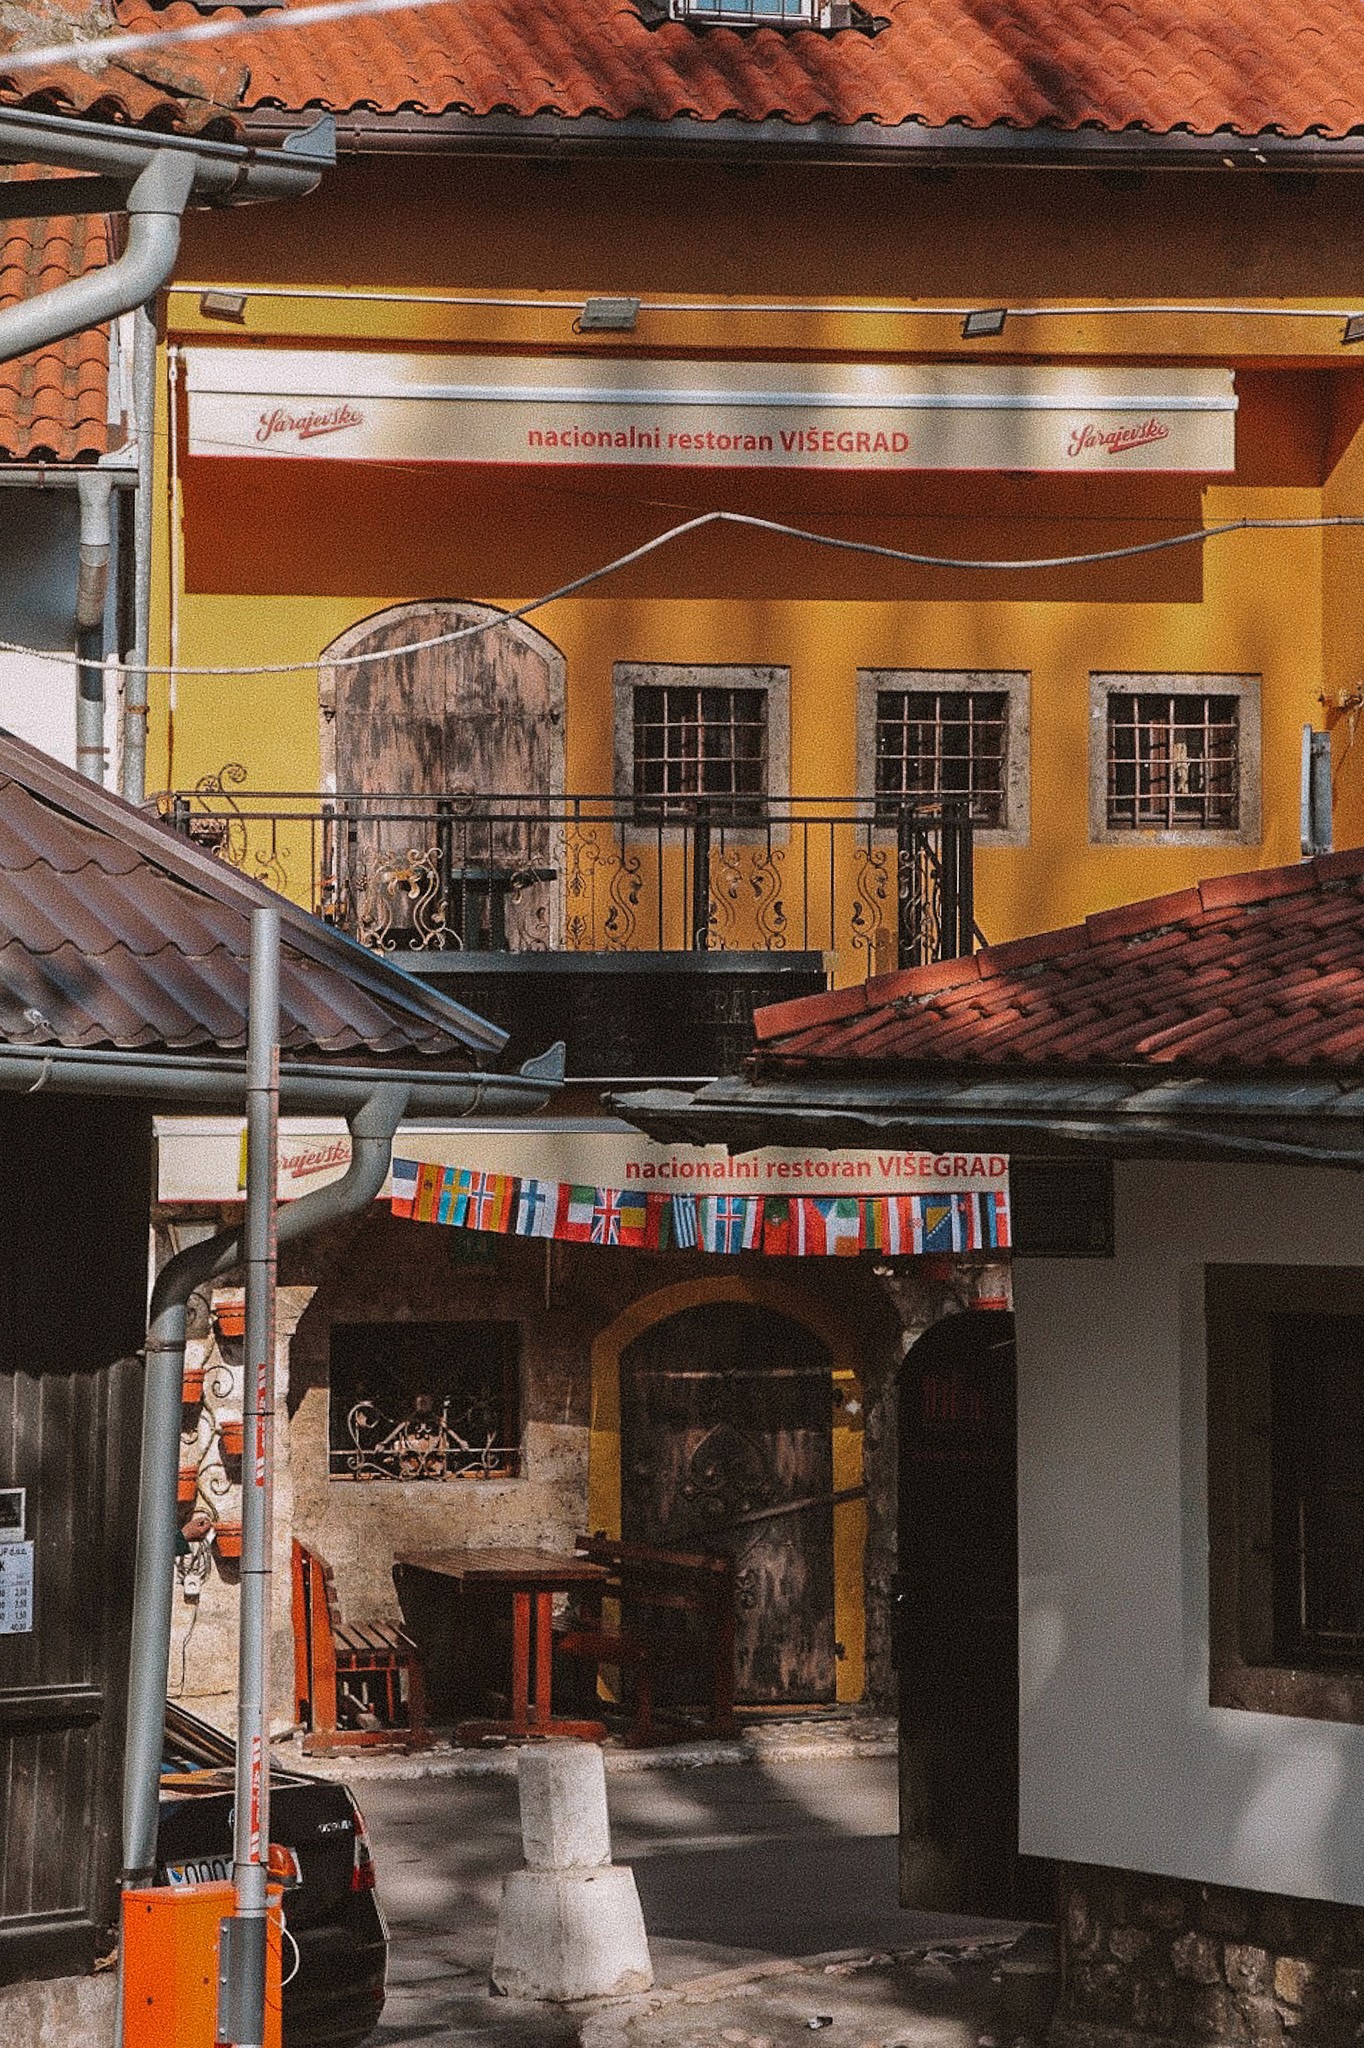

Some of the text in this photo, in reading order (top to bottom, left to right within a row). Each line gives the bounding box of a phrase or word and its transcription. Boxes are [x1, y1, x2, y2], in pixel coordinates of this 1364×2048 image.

[527, 425, 910, 454] nacionalni restoran VIŠEGRAD
[625, 1152, 1008, 1180] nacionalni restoran VIŠEGRAD
